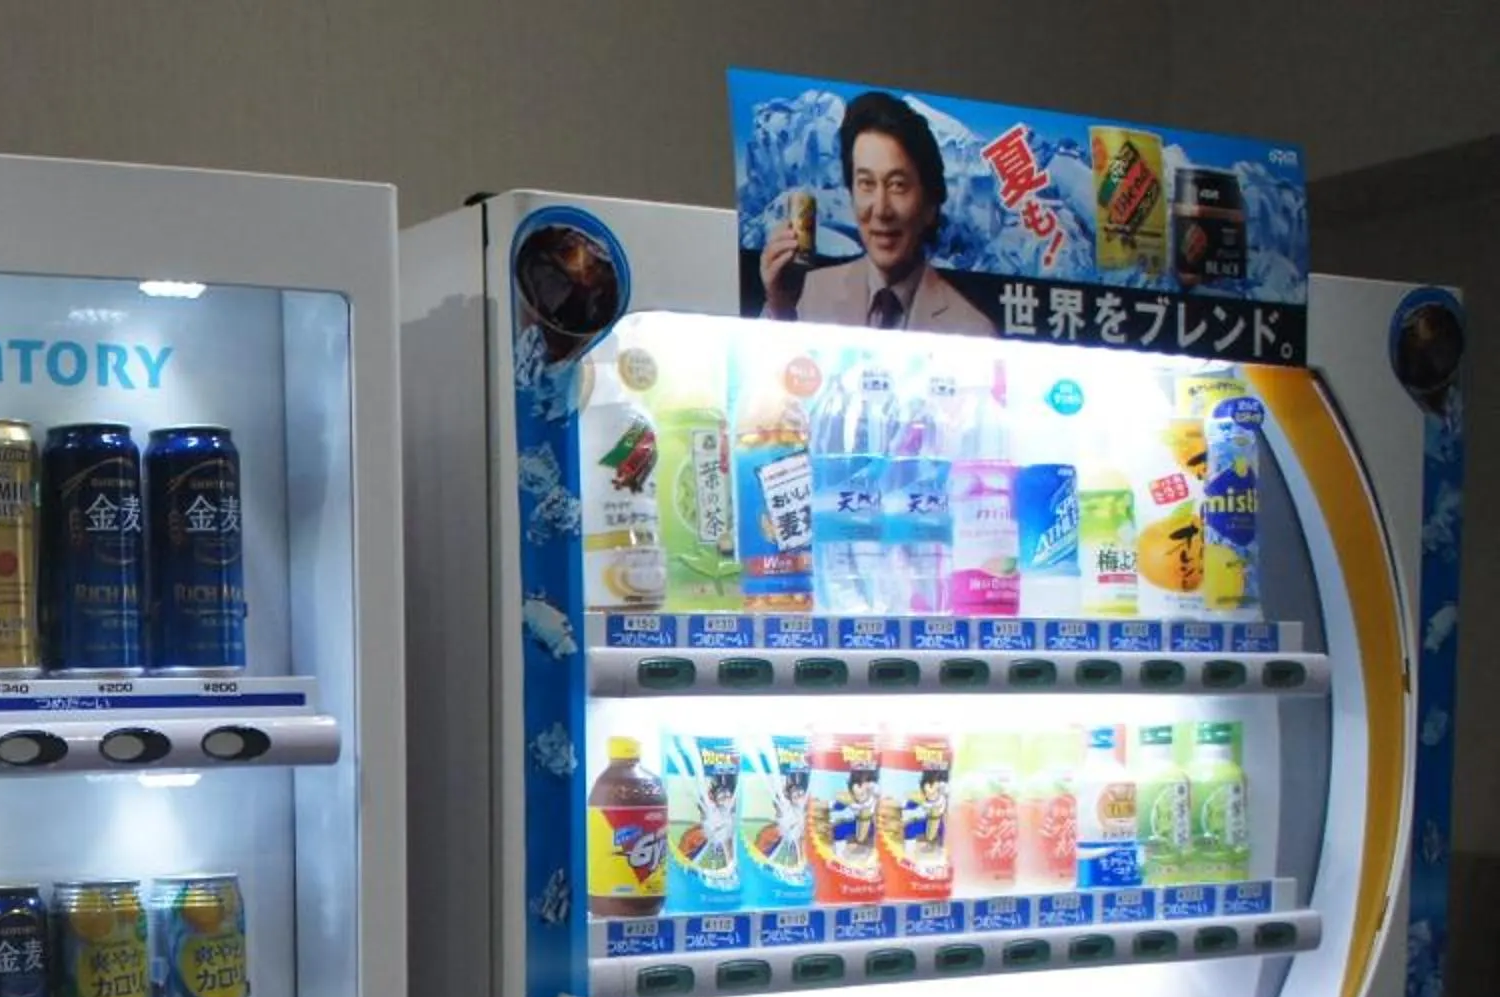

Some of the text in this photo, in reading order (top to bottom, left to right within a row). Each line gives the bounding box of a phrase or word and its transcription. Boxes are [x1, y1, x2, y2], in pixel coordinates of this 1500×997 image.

[1000, 283, 1294, 358] 世界をブレンド。
[85, 494, 142, 532] 金麦
[185, 494, 242, 532] 金麦
